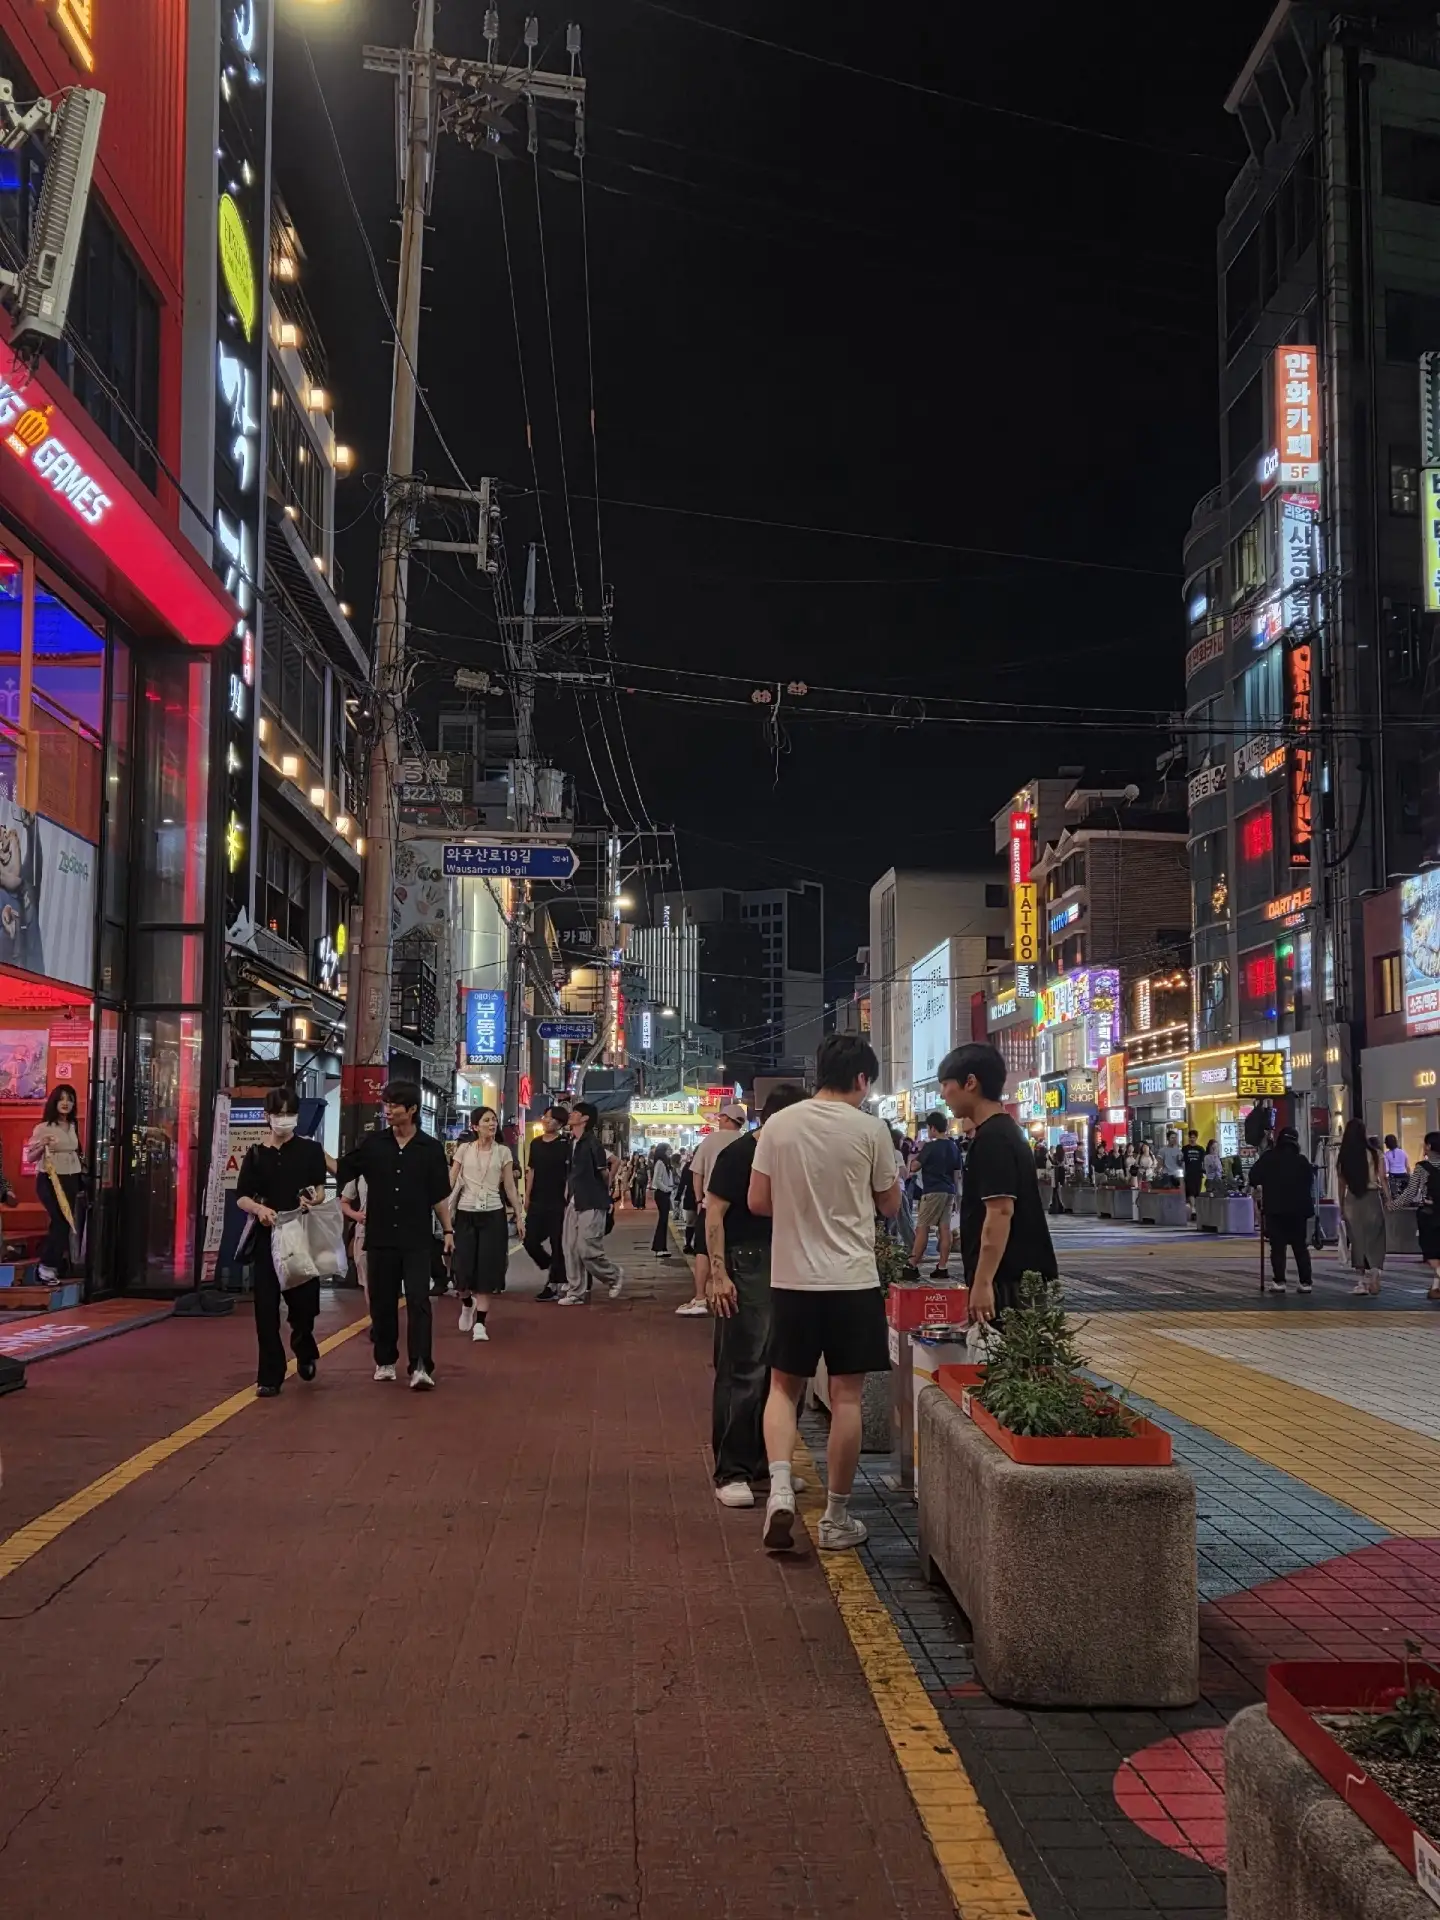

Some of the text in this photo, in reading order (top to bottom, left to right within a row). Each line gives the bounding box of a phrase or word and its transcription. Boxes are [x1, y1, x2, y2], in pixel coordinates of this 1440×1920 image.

[1284, 353, 1312, 458] 만화카페
[32, 437, 113, 526] GAMES
[1290, 466, 1310, 480] 5F
[447, 848, 531, 863] 와우산로19길
[447, 865, 527, 875] Wausan-ro 19-gil
[1020, 885, 1032, 959] TATTOO
[1018, 965, 1030, 998] VINTAGE
[476, 1002, 496, 1052] 부동산
[1239, 1053, 1284, 1075] 반값
[1071, 1083, 1093, 1091] VAPE
[1240, 1078, 1284, 1093] 방탈출
[1069, 1094, 1094, 1103] SHOP
